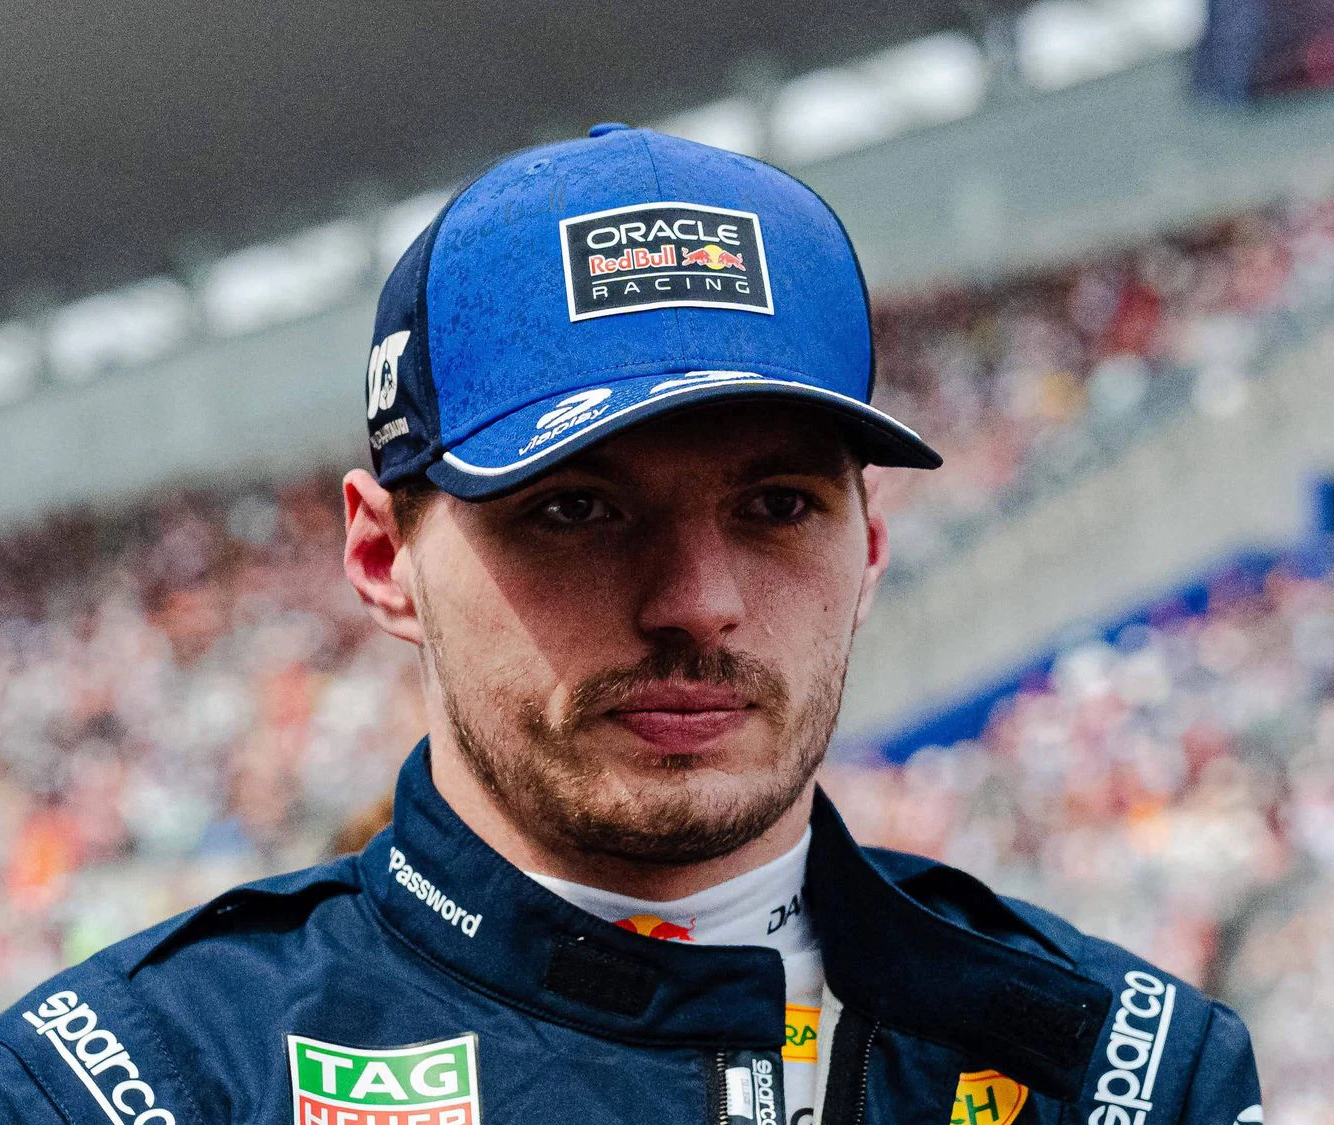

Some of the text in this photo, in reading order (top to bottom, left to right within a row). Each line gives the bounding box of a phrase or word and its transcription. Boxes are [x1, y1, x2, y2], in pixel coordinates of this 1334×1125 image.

[586, 219, 741, 249] ORACLE
[588, 244, 677, 277] Red Bull
[592, 277, 750, 300] RACING
[519, 404, 610, 456] viaplay
[388, 846, 483, 938] Password
[305, 1049, 459, 1101] TAG
